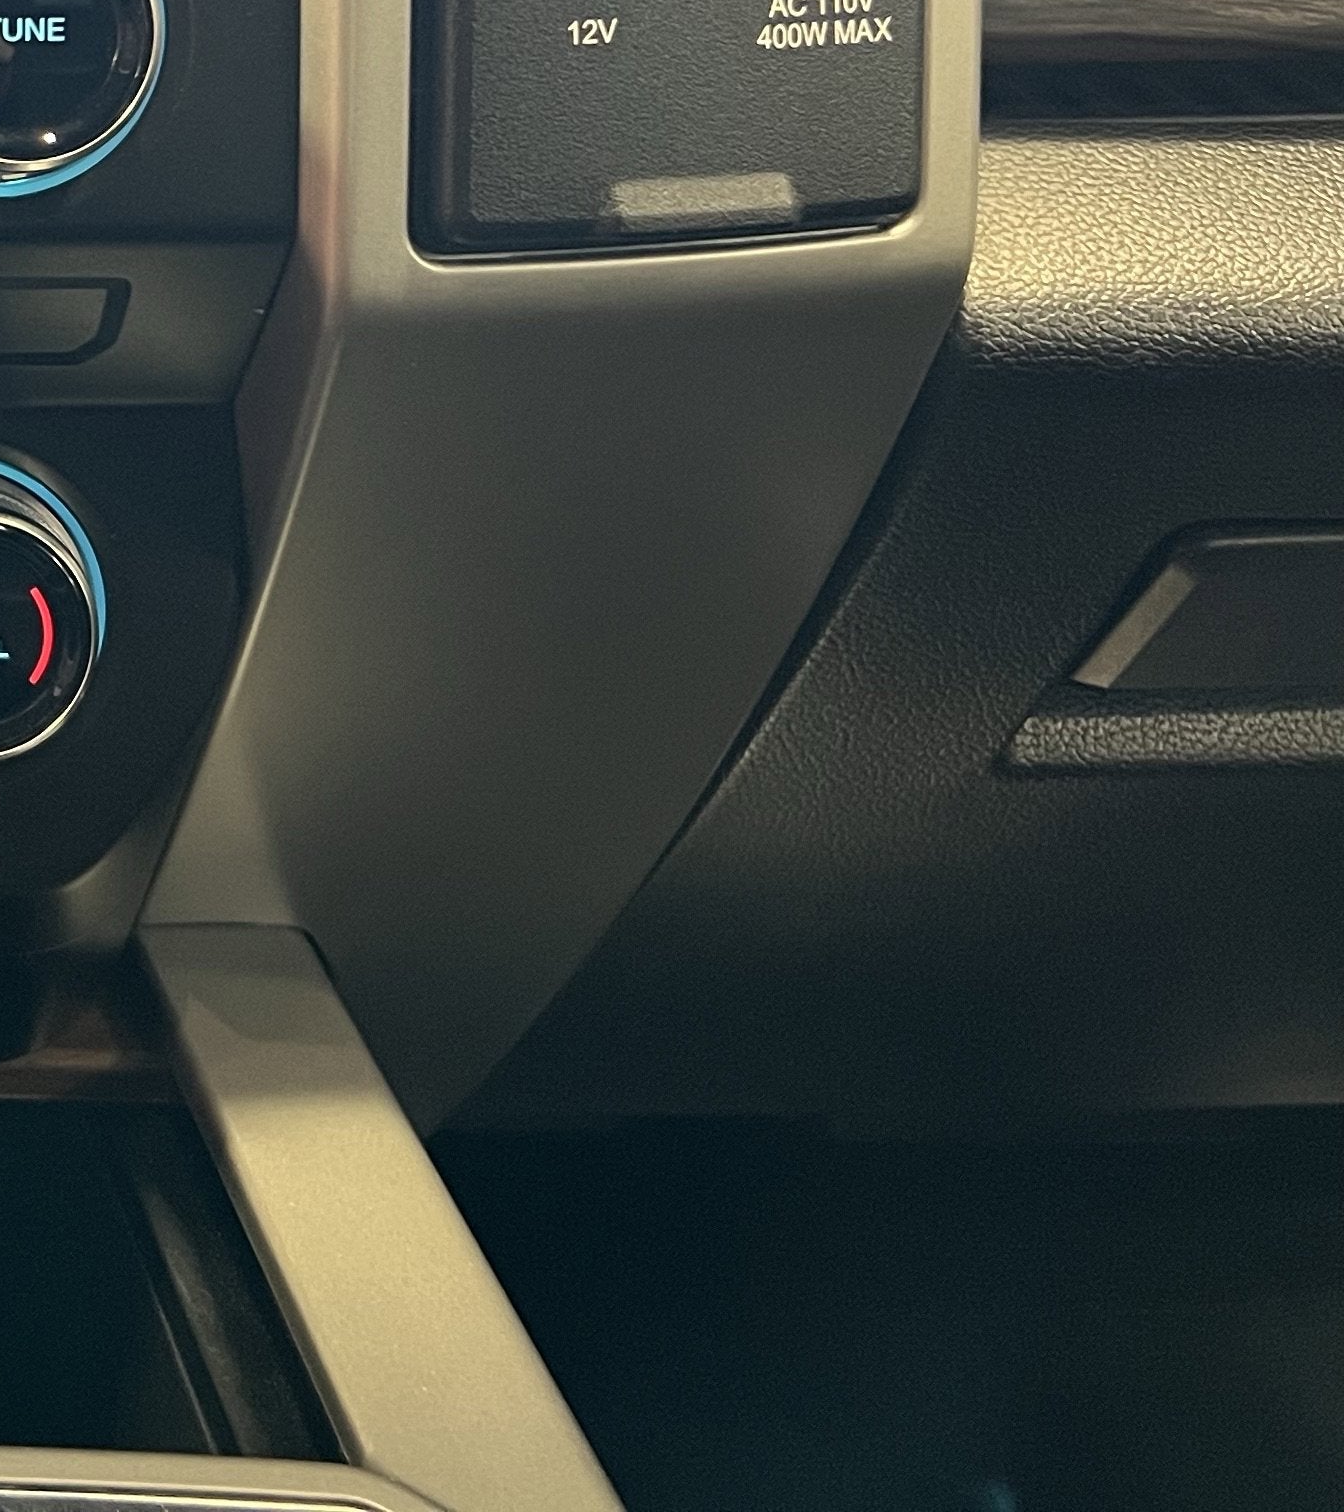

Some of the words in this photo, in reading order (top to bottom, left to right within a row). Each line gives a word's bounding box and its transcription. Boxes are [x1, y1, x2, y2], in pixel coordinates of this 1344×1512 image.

[567, 17, 618, 46] 12V
[756, 21, 829, 50] 400W
[834, 15, 893, 45] MAX
